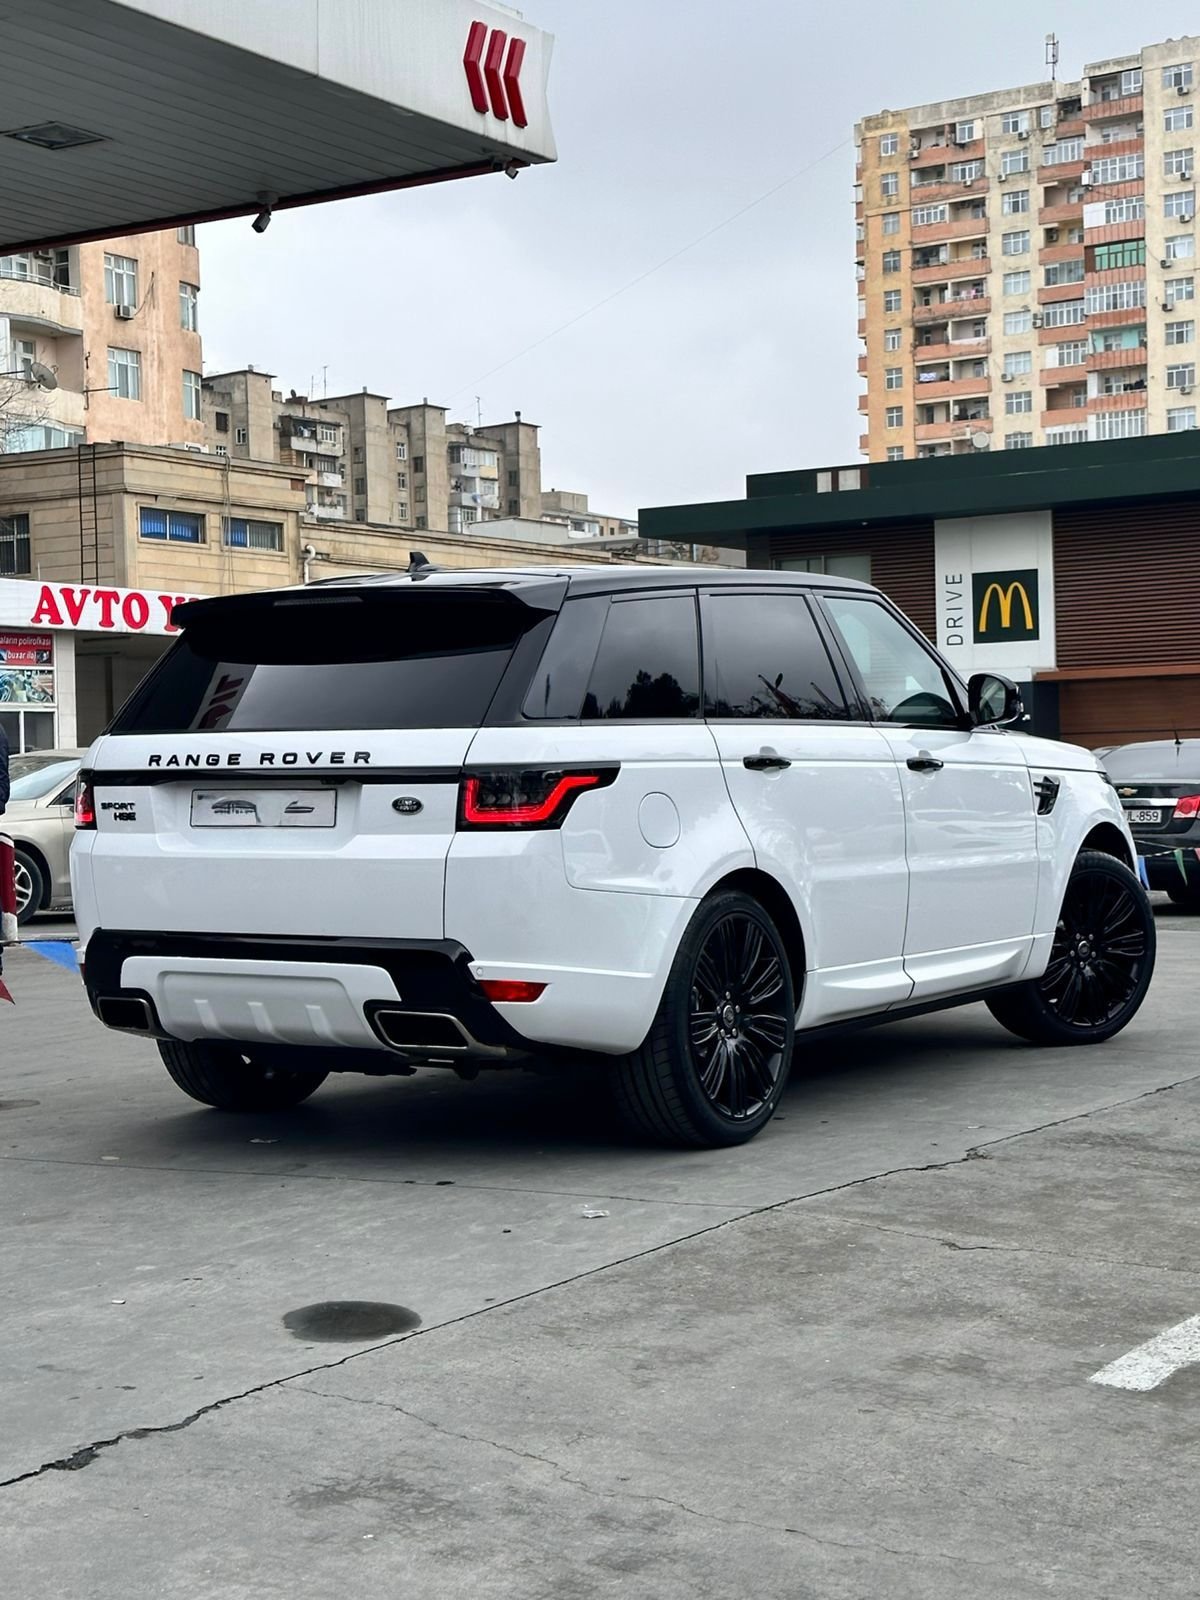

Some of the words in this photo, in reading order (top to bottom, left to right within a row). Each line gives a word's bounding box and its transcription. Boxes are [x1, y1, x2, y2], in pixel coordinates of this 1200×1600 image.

[30, 585, 150, 629] AVTO
[945, 573, 964, 646] DRIVE
[148, 753, 242, 767] RANGE
[259, 751, 371, 765] ROVER
[100, 802, 136, 811] SPORT
[113, 811, 137, 821] HSE
